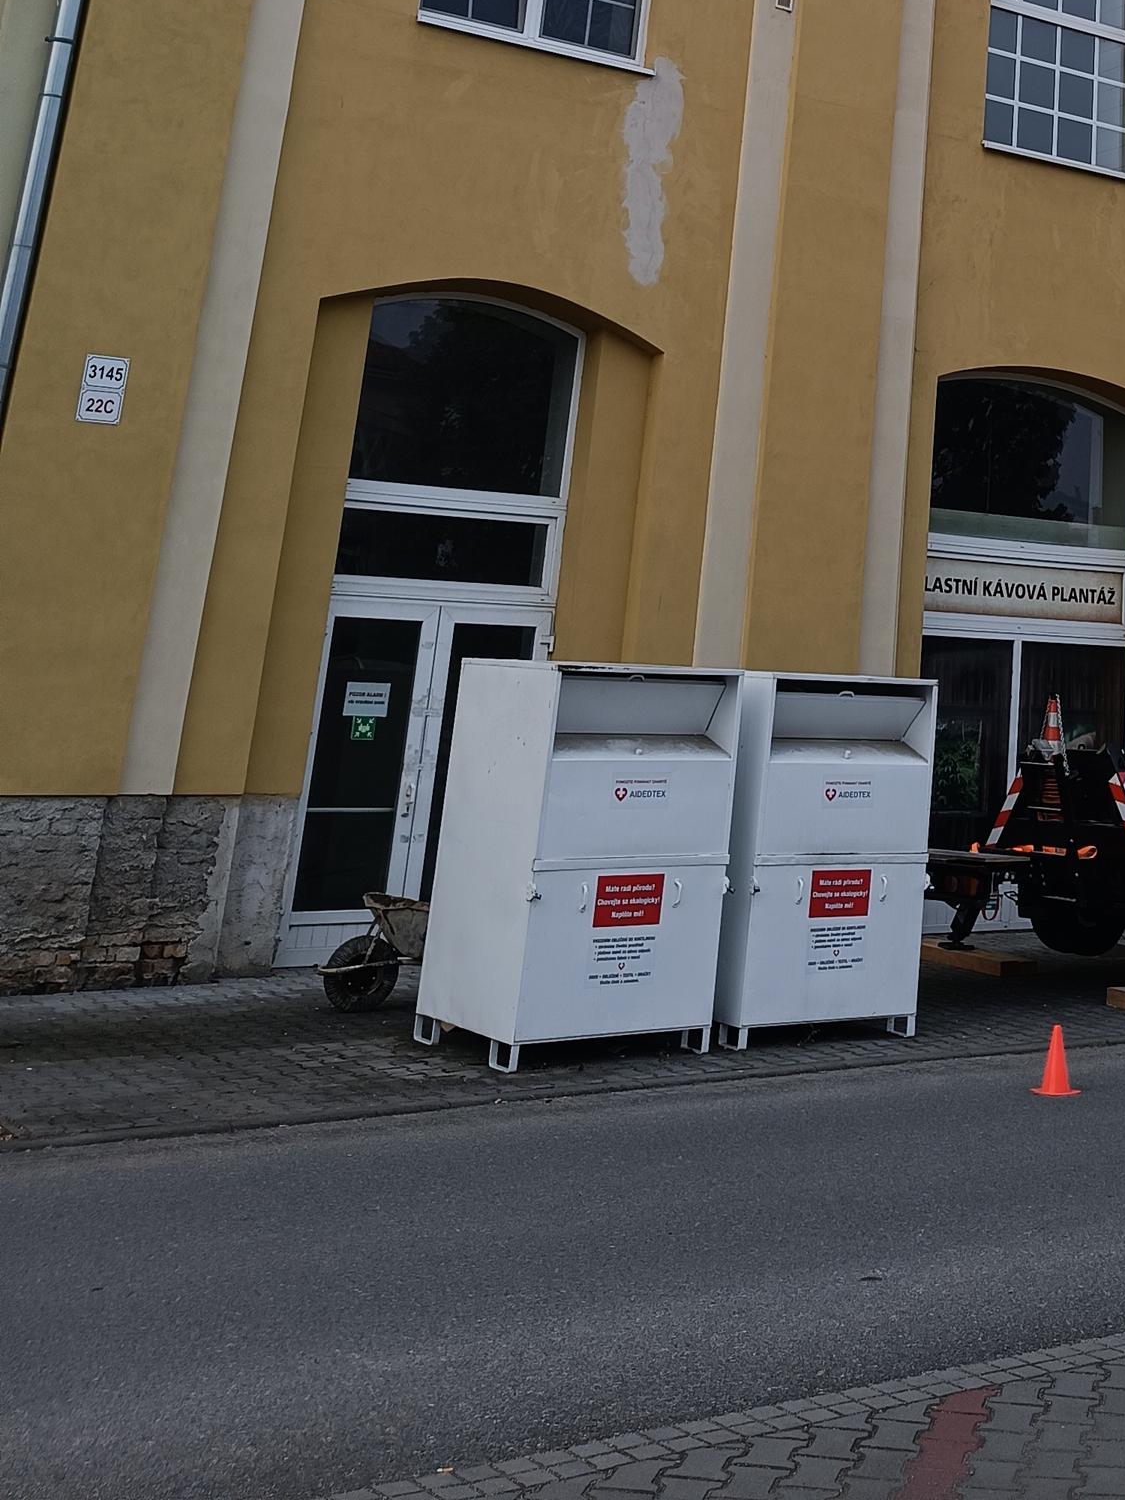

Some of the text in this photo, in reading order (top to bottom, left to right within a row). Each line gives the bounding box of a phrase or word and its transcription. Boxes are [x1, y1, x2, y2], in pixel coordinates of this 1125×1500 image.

[88, 364, 124, 381] 3145
[85, 398, 115, 414] 22C
[924, 576, 1116, 605] LASTNÍ KÁVOVÁ PLANTÁŽ
